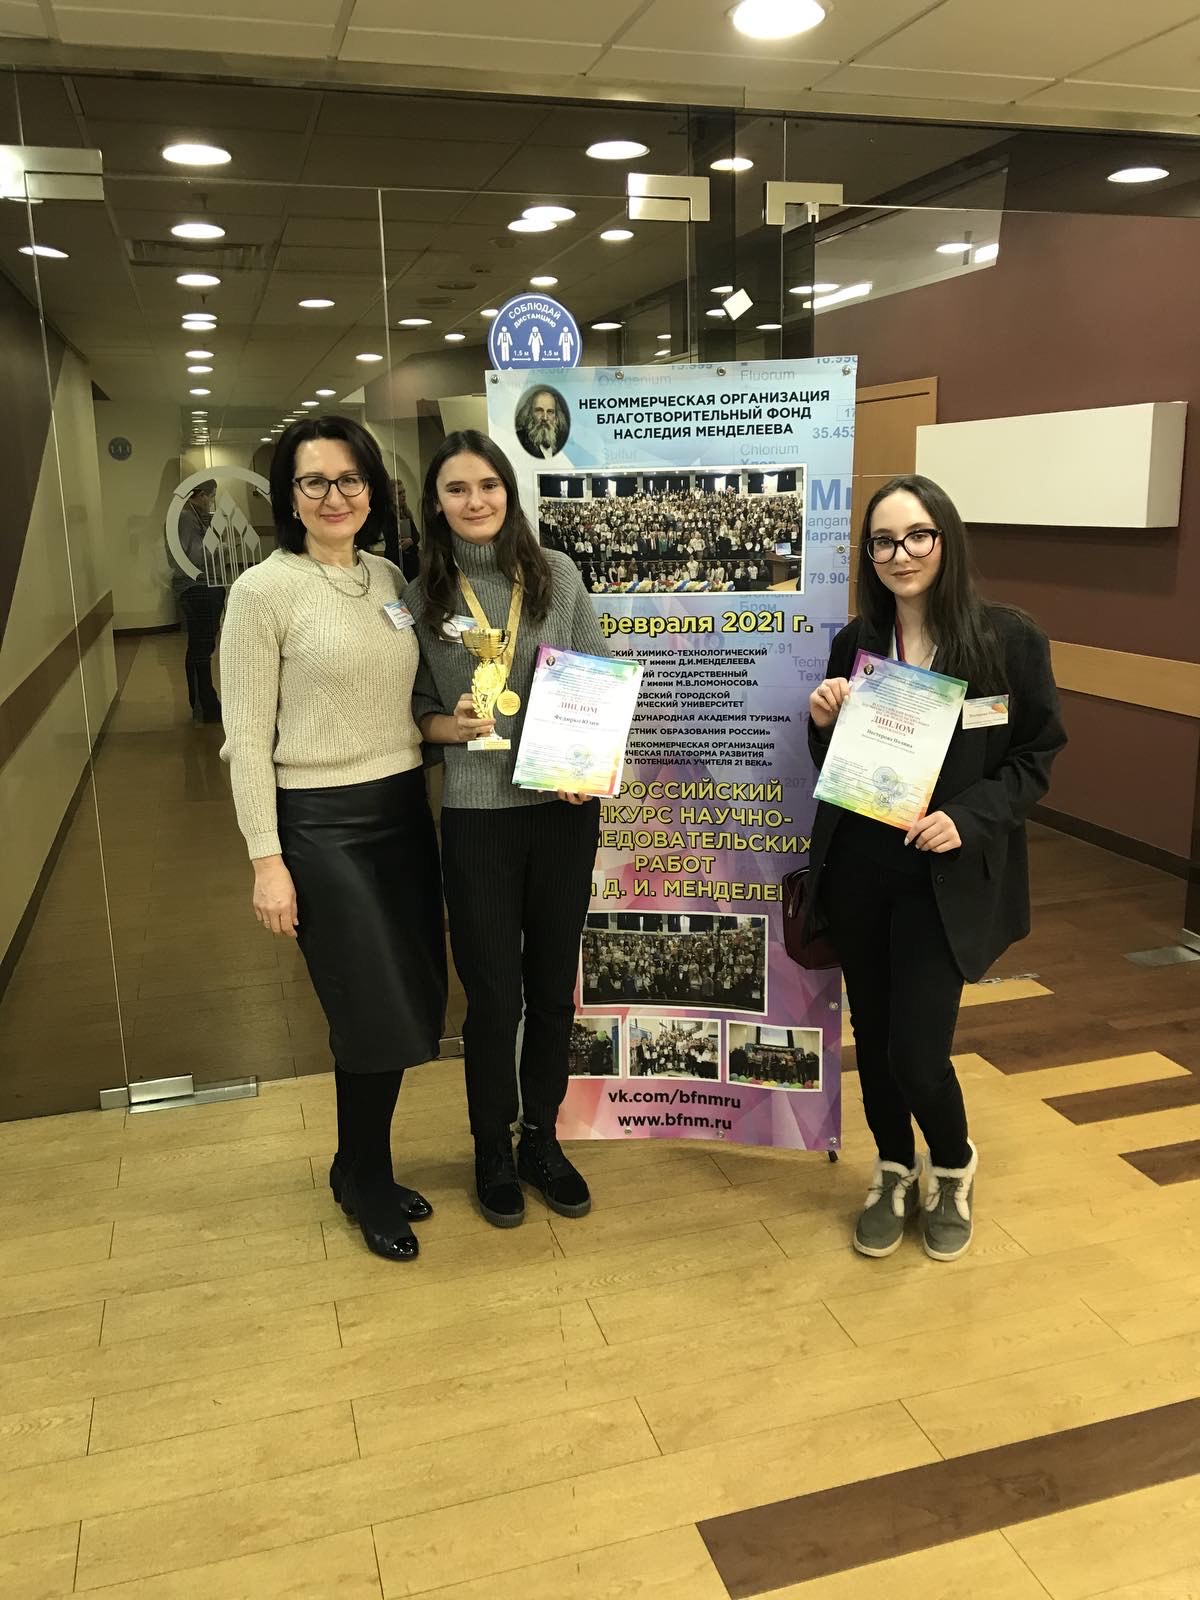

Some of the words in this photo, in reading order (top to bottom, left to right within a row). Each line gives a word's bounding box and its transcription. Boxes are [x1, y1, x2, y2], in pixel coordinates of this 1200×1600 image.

[508, 302, 561, 320] СОБЛЮДАЙ
[513, 313, 557, 328] ДИСТАНЦИЮ
[740, 369, 795, 381] Fluorum
[579, 394, 716, 410] НЕКОММЕРЧЕСКАЯ
[720, 390, 830, 404] ОРГАНИЗАЦИЯ
[596, 405, 762, 424] БЛАГОТВОРИТЕЛЬНЫЙ
[767, 406, 811, 420] ФОНД
[614, 426, 691, 440] НАСЛЕДИЯ
[696, 423, 793, 438] МЕНДЕЛЕЕВА
[740, 443, 799, 456] Chlorium
[598, 612, 715, 639] февраля
[721, 610, 785, 633] 2021
[792, 614, 814, 633] г.
[636, 647, 768, 657] ХИМИКО-ТЕХНОЛОГИЧЕСКИЙ
[678, 658, 756, 666] Д.И.МЕНДЕЛЕЕВА
[657, 669, 748, 679] ГОСУДАРСТВЕННЫЙ
[675, 679, 759, 687] М.В.ЛОМОНОСОВА
[675, 691, 730, 700] ГОРОДСКОЙ
[680, 700, 744, 708] УНИВЕРСИТЕТ
[697, 714, 747, 722] АКАДЕМИЯ
[749, 714, 791, 723] ТУРИЗМА
[871, 715, 915, 735] ДИПЛОМ
[728, 728, 771, 736] РОССИИ»
[630, 741, 710, 749] НЕКОММЕРЧЕСКАЯ
[711, 741, 775, 750] ОРГАНИЗАЦИЯ
[720, 750, 764, 758] РАЗВИТИЯ
[634, 758, 694, 766] ПОТЕНЦИАЛА
[694, 758, 733, 766] УЧИТЕЛЯ
[744, 759, 773, 767] ВЕКА»
[680, 806, 793, 828] НАУЧНО-
[634, 854, 716, 874] РАБОТ
[603, 878, 627, 899] Д.
[633, 879, 657, 897] И.
[608, 1089, 741, 1109] vk.com/bfnmru
[618, 1113, 732, 1130] www.bfnm.ru
